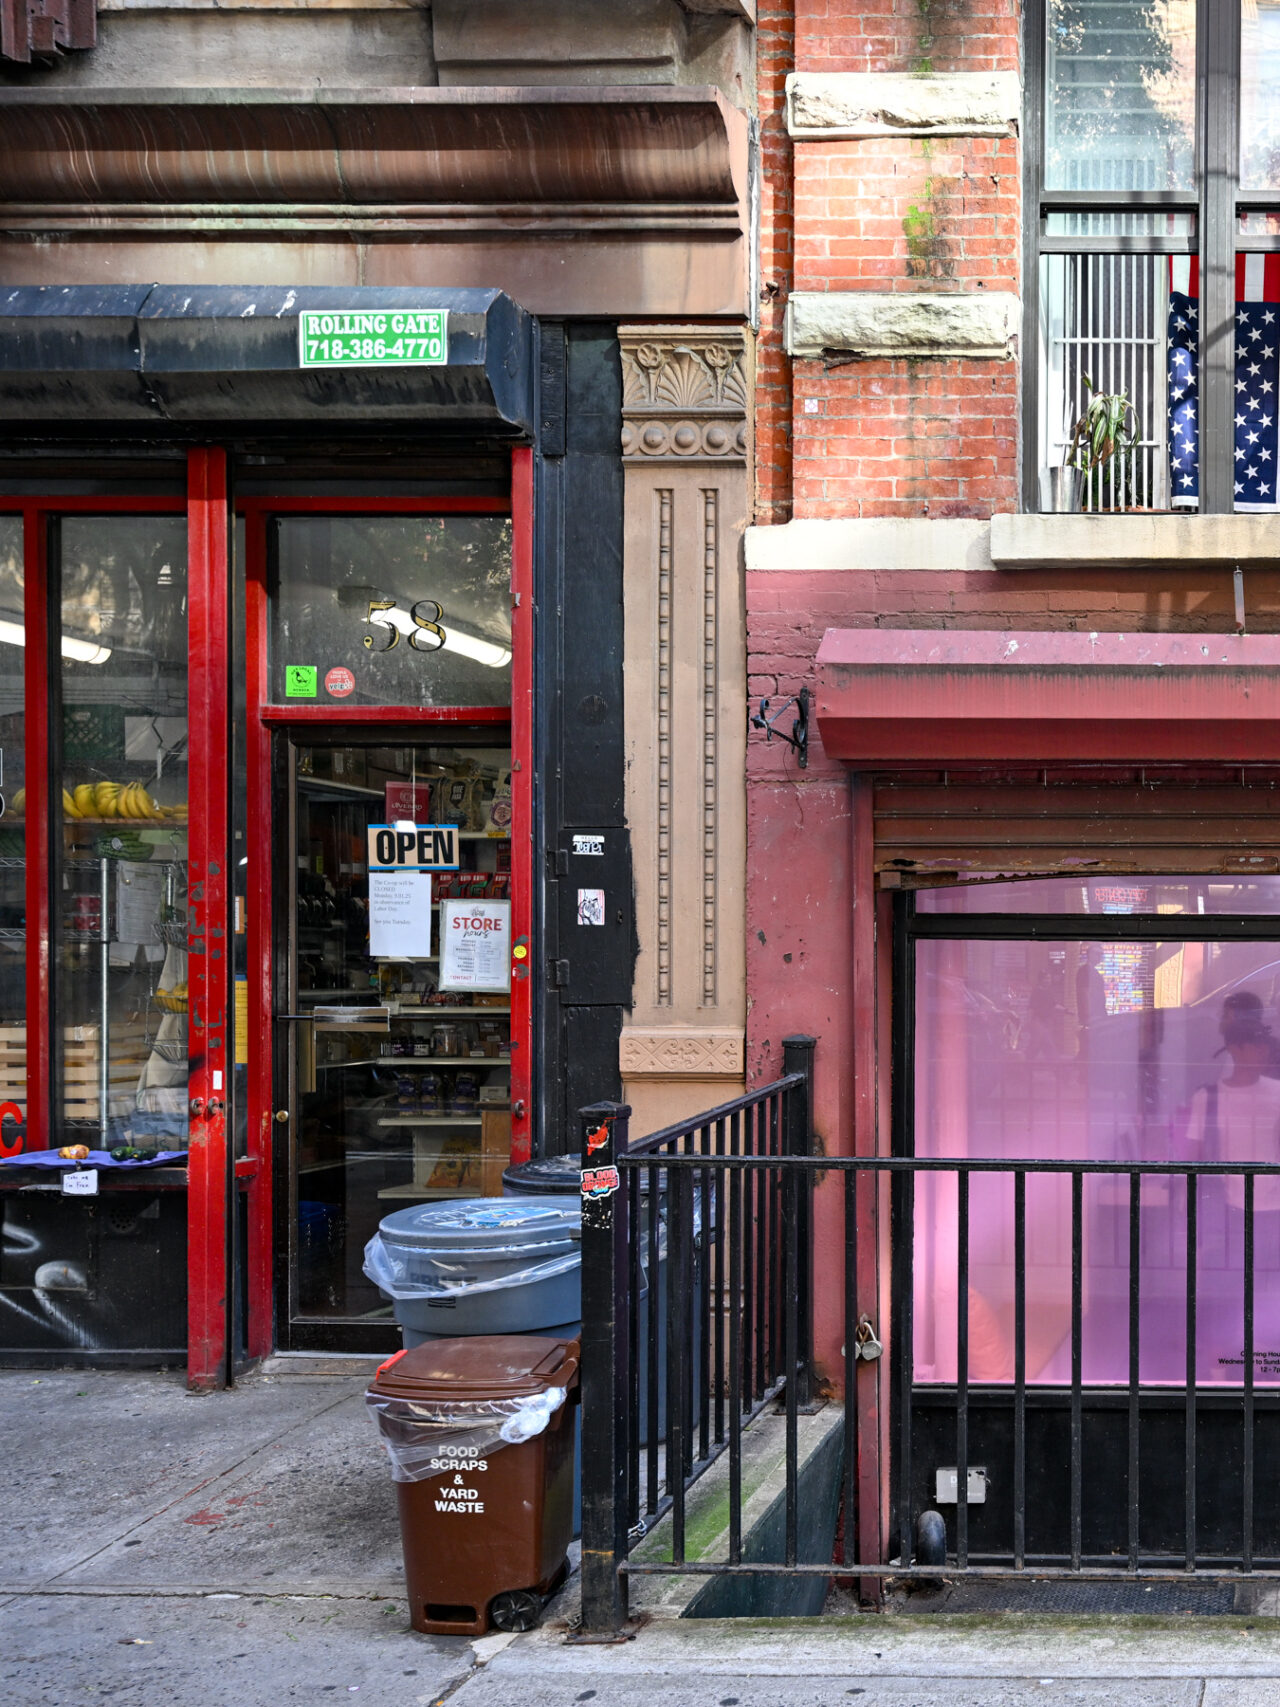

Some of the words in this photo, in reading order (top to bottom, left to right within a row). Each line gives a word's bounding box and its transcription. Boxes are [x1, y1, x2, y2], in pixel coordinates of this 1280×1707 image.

[308, 315, 387, 335] ROLLING
[391, 315, 440, 334] GATE
[307, 338, 440, 360] 718-386-4770
[363, 600, 446, 652] 58
[376, 829, 454, 865] OPEN
[452, 917, 502, 931] STORE
[463, 928, 489, 939] hours
[584, 1170, 616, 1182] BLOOD
[438, 1446, 479, 1457] FOOD
[430, 1458, 488, 1471] SCRAPS
[453, 1474, 464, 1485] &
[440, 1487, 478, 1499] YARD
[434, 1500, 485, 1513] WASTE
